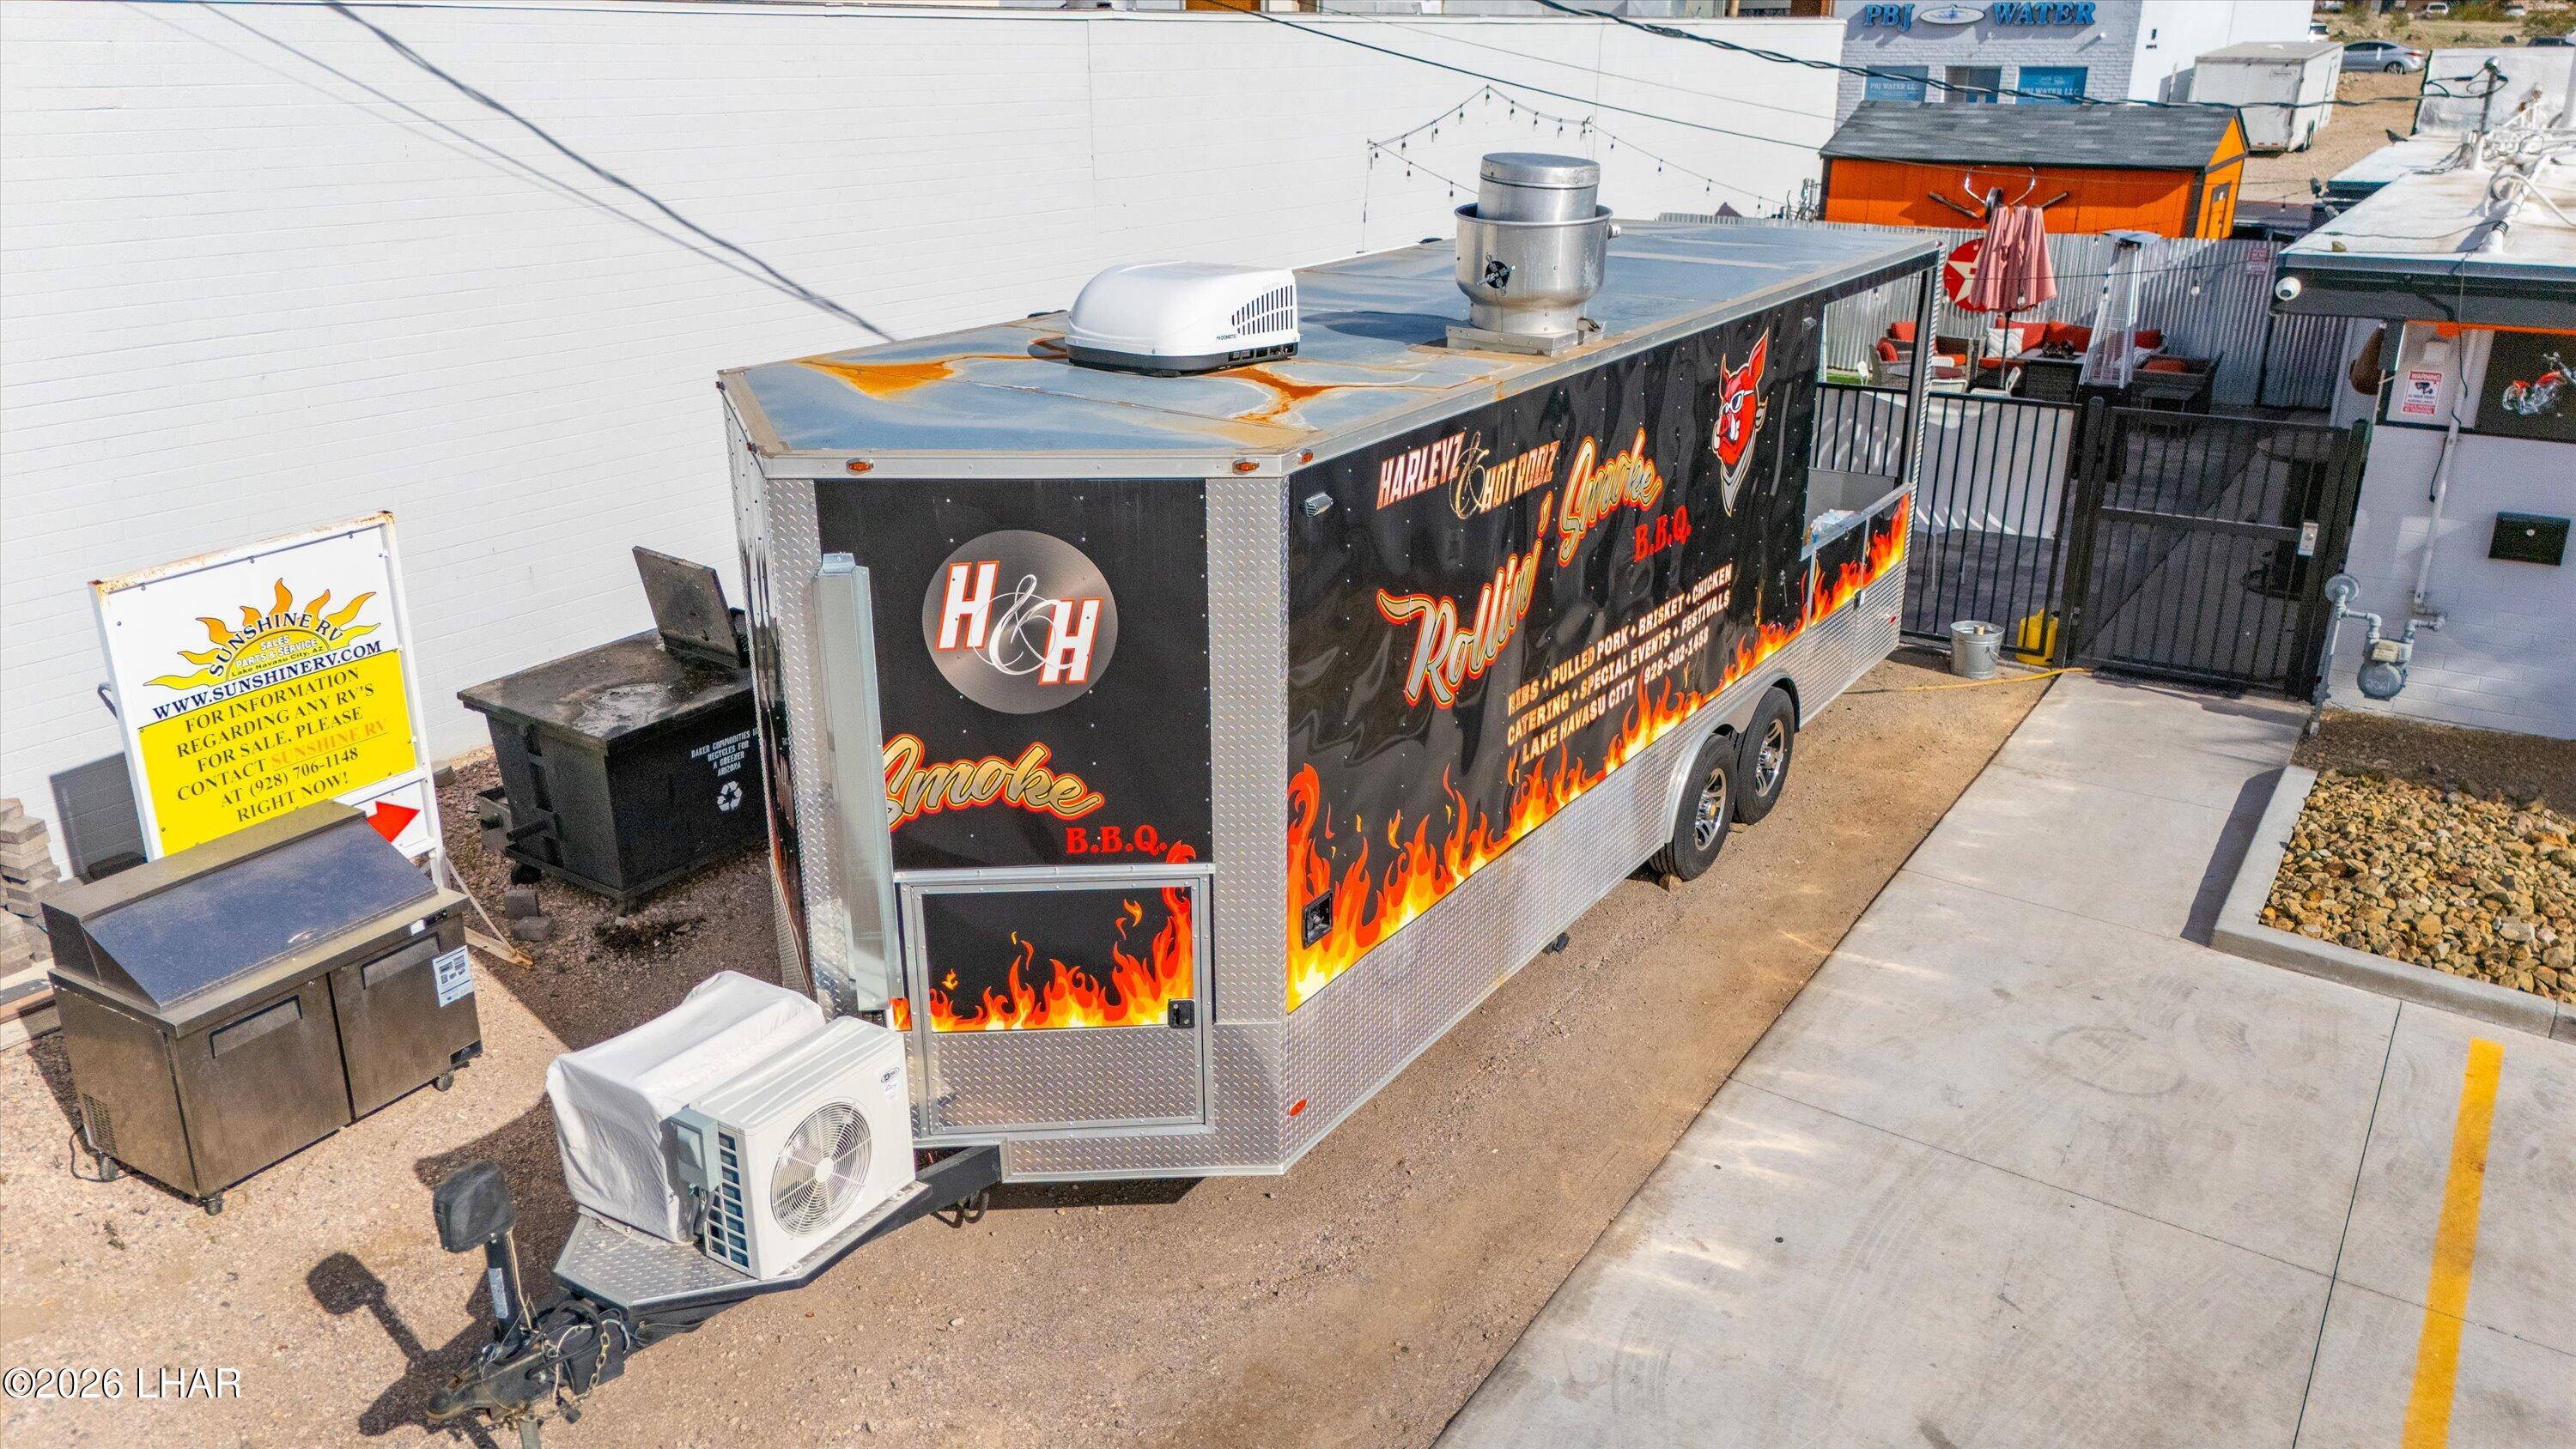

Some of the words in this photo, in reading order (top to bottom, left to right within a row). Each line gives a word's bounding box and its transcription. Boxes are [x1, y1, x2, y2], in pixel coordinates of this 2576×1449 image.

[1863, 3, 1916, 33] PBJ
[1993, 2, 2097, 26] WATER
[2064, 88, 2081, 96] LLC
[1376, 431, 1466, 511] HARLEYZ
[1449, 430, 1490, 519] &
[1479, 458, 1516, 515] HOT
[1513, 440, 1561, 498] RODZ
[1558, 427, 1663, 567] Smoke
[1633, 505, 1692, 563] B.B.Q.
[210, 612, 313, 677] SUNSHINE
[314, 619, 343, 642] RV
[232, 666, 253, 677] Lake
[255, 656, 289, 670] Havasu
[236, 652, 267, 669] PARTS
[269, 650, 276, 659] &
[277, 638, 319, 657] SERVICE
[260, 634, 290, 651] SALES
[1507, 679, 1540, 718] RIBS
[1551, 646, 1595, 689] PULLED
[1596, 624, 1630, 661] PORK
[1638, 592, 1686, 637] BRISKET
[1692, 562, 1733, 603] CHICKEN
[1507, 692, 1570, 747] CATERING
[1579, 664, 1628, 700] SPECIAL
[1630, 628, 1672, 668] EVENTS
[1680, 589, 1730, 638] FESTIVALS
[153, 640, 383, 720] WWW.SUNSHINERV.COM
[185, 708, 223, 733] FOR
[228, 667, 361, 719] INFORMATION
[1522, 727, 1558, 765] LAKE
[1559, 696, 1607, 742] HAVASU
[1608, 675, 1637, 709] CITY
[1643, 626, 1710, 685] 928-302-1458
[177, 709, 290, 758] REGARDING
[295, 694, 331, 719] ANY
[337, 682, 374, 706] RV'S
[197, 749, 236, 773] FOR
[295, 706, 363, 739] PLEASE
[691, 745, 710, 758] BAKER
[713, 731, 750, 750] COMMODITIES
[177, 758, 267, 801] CONTACT
[271, 726, 361, 768] SUNSHINE
[365, 718, 388, 737] RV
[221, 787, 243, 808] AT
[249, 771, 289, 797] (928)
[293, 747, 359, 779] 706-1148
[708, 745, 736, 762] RECYCLES
[738, 740, 749, 751] FOR
[718, 761, 741, 777] ARIZONA
[720, 751, 744, 766] GREENER
[236, 790, 296, 822] RIGHT
[301, 771, 349, 797] NOW!
[882, 733, 1105, 834] Smoke
[1066, 824, 1168, 855] B.B.Q.
